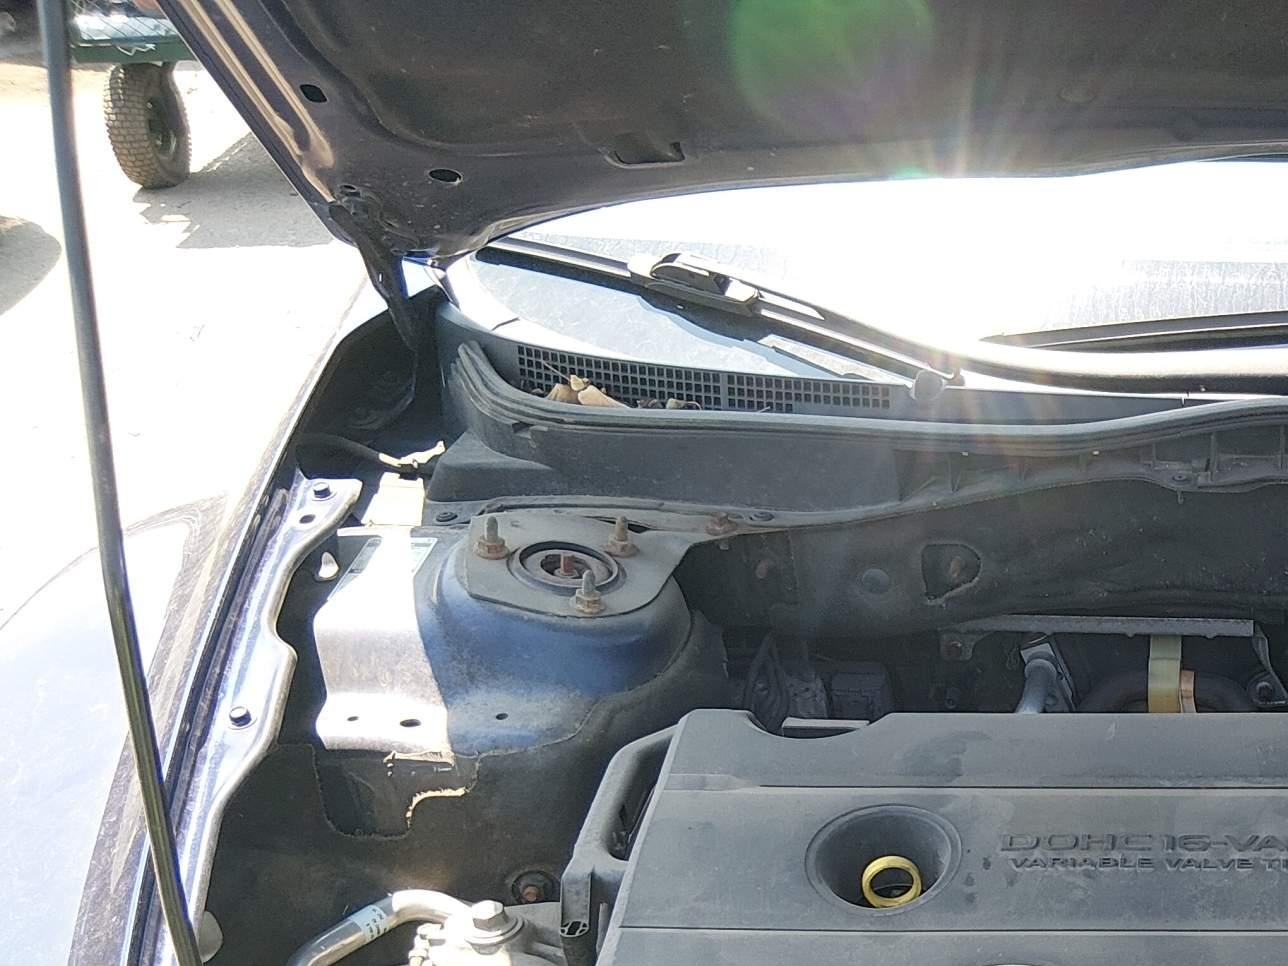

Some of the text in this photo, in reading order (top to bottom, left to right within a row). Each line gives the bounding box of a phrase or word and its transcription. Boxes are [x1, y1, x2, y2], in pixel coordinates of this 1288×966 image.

[1000, 834, 1153, 852] DOHC
[1009, 857, 1153, 870] VARIABLE
[1165, 857, 1254, 870] VALVE
